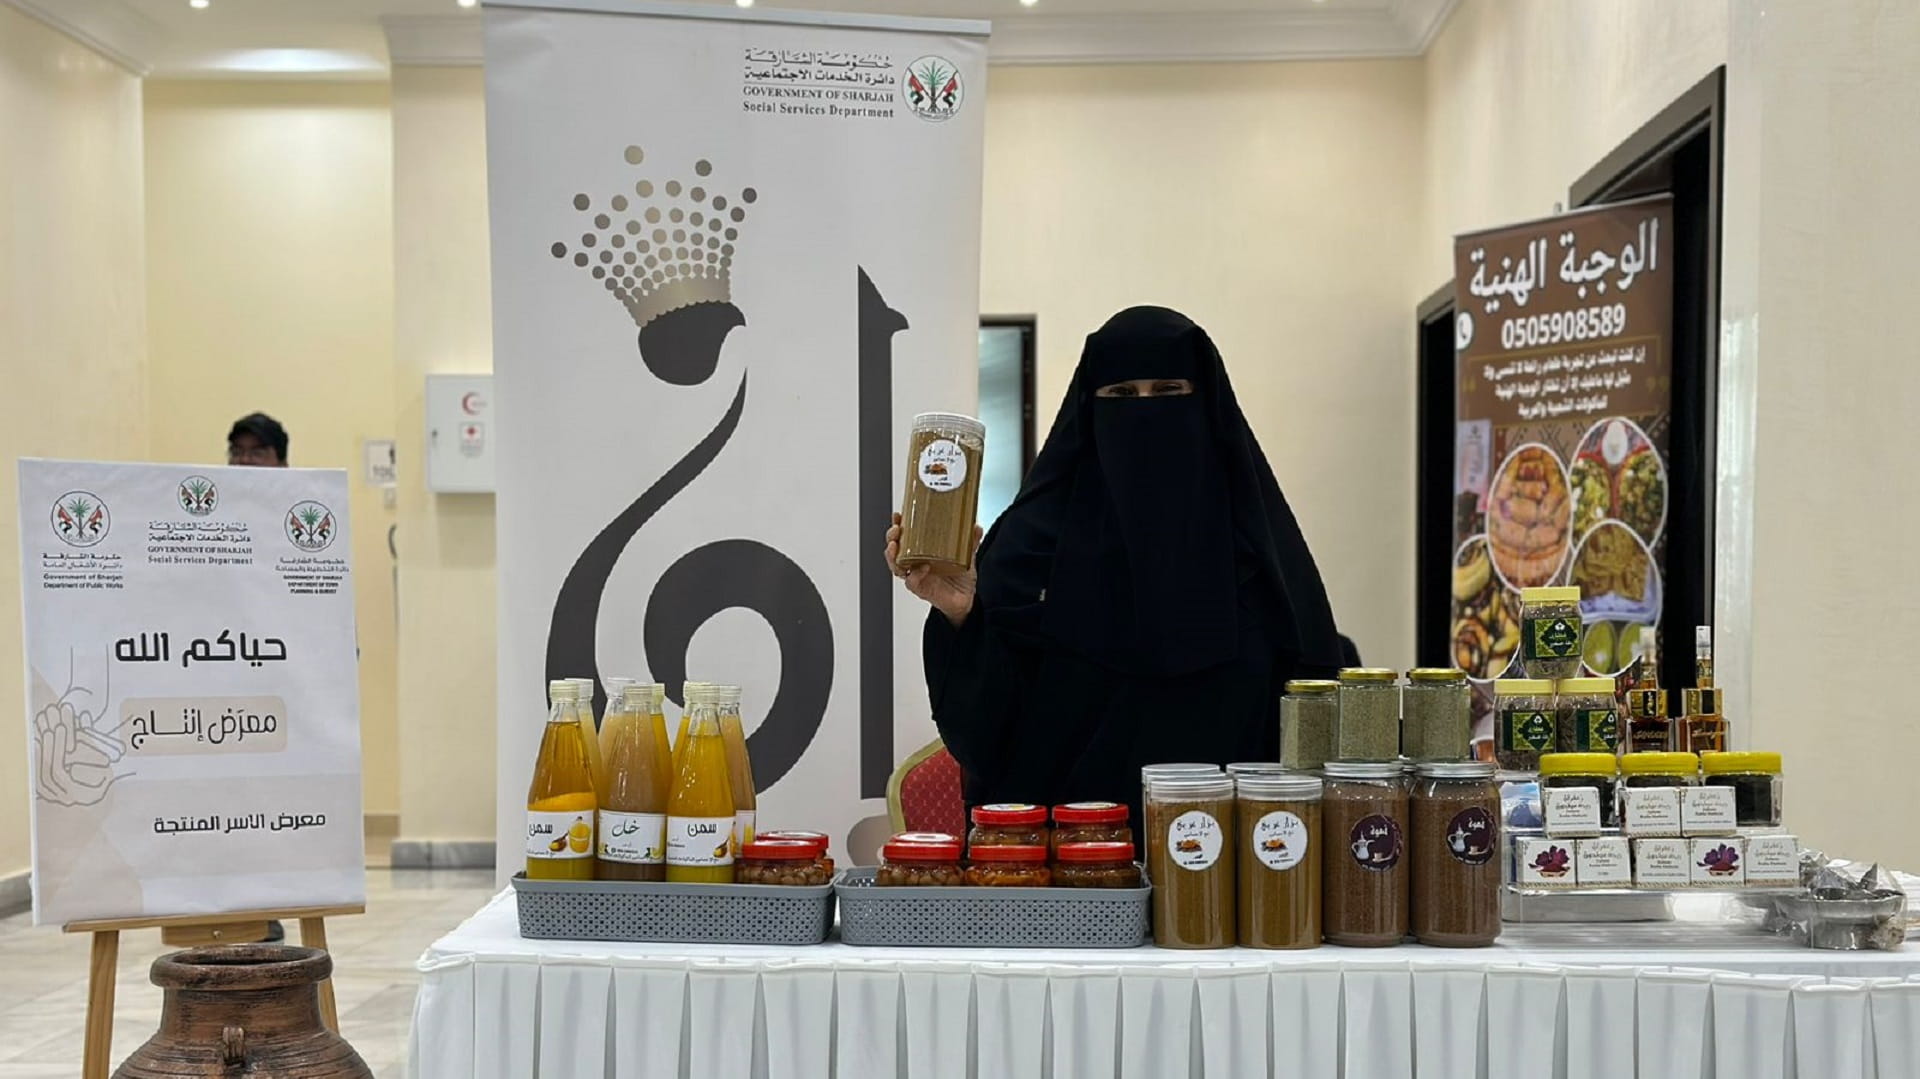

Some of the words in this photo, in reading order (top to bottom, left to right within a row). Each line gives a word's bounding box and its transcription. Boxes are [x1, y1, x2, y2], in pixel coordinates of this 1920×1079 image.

[744, 66, 811, 82] الاجتماعية
[815, 69, 862, 82] الخدمات
[865, 72, 895, 86] دائرة
[743, 86, 822, 98] GOVERNMENT
[826, 90, 840, 99] OF
[842, 90, 894, 102] SHARJAH
[743, 101, 776, 113] Social
[779, 102, 825, 115] Services
[829, 104, 894, 118] Department
[1559, 217, 1659, 299] الوجبة
[1470, 237, 1548, 314] الهنية
[1501, 303, 1627, 349] 0505908589
[147, 545, 203, 553] GOVERNMENT
[148, 555, 172, 564] Social
[174, 556, 206, 564] Services
[208, 556, 253, 565] Department
[115, 632, 169, 661] الله
[182, 629, 287, 667] حياكم
[153, 815, 220, 836] المنتجة
[224, 813, 265, 833] الاسر
[270, 812, 326, 831] معرض
[529, 823, 553, 837] سمن
[611, 818, 640, 837] خل
[688, 823, 717, 837] سمن
